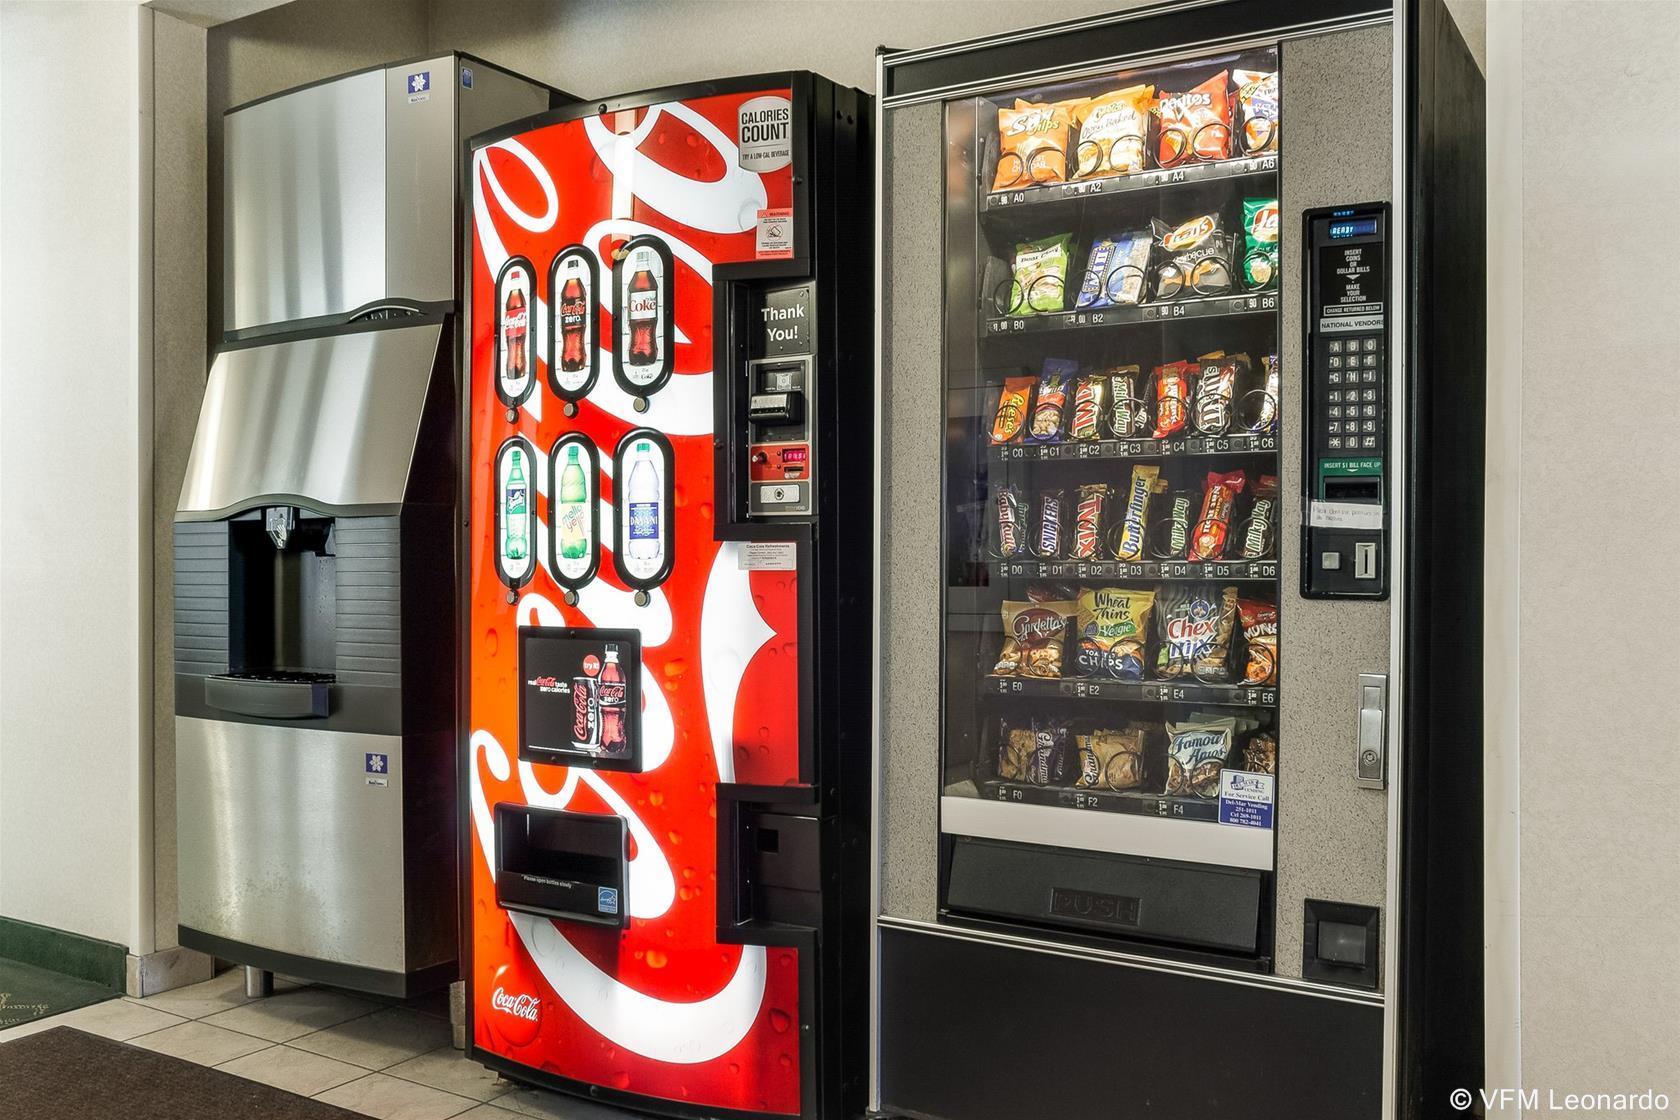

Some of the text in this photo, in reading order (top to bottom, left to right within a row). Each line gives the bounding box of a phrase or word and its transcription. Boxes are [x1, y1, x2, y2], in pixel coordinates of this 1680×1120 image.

[741, 108, 789, 125] CALORIES
[742, 122, 789, 143] COUNT
[771, 149, 789, 157] BEVERAGE
[1262, 160, 1275, 169] A6
[1172, 172, 1184, 181] A4
[1090, 182, 1102, 193] A2
[1013, 192, 1024, 203] A0
[1332, 226, 1354, 234] READY
[1336, 267, 1356, 275] DOLLAR
[629, 300, 656, 312] Coke
[1262, 298, 1275, 308] B6
[761, 304, 805, 322] Thank
[1173, 306, 1185, 316] B4
[1092, 314, 1104, 323] B2
[1013, 320, 1025, 330] B0
[1321, 320, 1353, 329] NATIONAL
[767, 325, 798, 341] You!
[1173, 441, 1185, 452] C4
[1216, 440, 1229, 450] C5
[1262, 438, 1274, 448] C6
[1012, 448, 1023, 458] C0
[1049, 447, 1060, 456] C1
[1088, 446, 1100, 455] C2
[1130, 444, 1141, 453] C3
[1342, 461, 1348, 469] $1
[562, 504, 583, 524] mello
[1120, 476, 1149, 553] Butterfinger
[630, 517, 658, 526] DASANI
[1042, 496, 1059, 551] SNICKERS
[1077, 493, 1104, 557] TWIX
[1171, 515, 1189, 551] Milky
[1245, 517, 1269, 554] Milky
[1012, 565, 1023, 575] D0
[1052, 566, 1062, 575] D1
[1091, 565, 1102, 575] D2
[1130, 566, 1142, 575] D3
[1174, 566, 1186, 575] D4
[1217, 566, 1229, 576] D5
[1262, 566, 1275, 576] D6
[1094, 592, 1131, 609] Wheat
[1092, 607, 1131, 621] Thins
[1098, 621, 1133, 637] Veggie
[1167, 616, 1220, 641] Chex
[1169, 638, 1216, 660] Mix
[1079, 655, 1123, 670] CHIPS
[1012, 682, 1022, 691] E0
[1089, 686, 1100, 695] E2
[1173, 689, 1184, 699] E4
[1262, 693, 1274, 703] E6
[587, 697, 595, 729] zero
[1012, 791, 1022, 800] F0
[1088, 797, 1098, 807] F2
[1247, 802, 1268, 810] Vending
[1173, 805, 1184, 814] F4
[492, 987, 541, 1022] Coca-Cola
